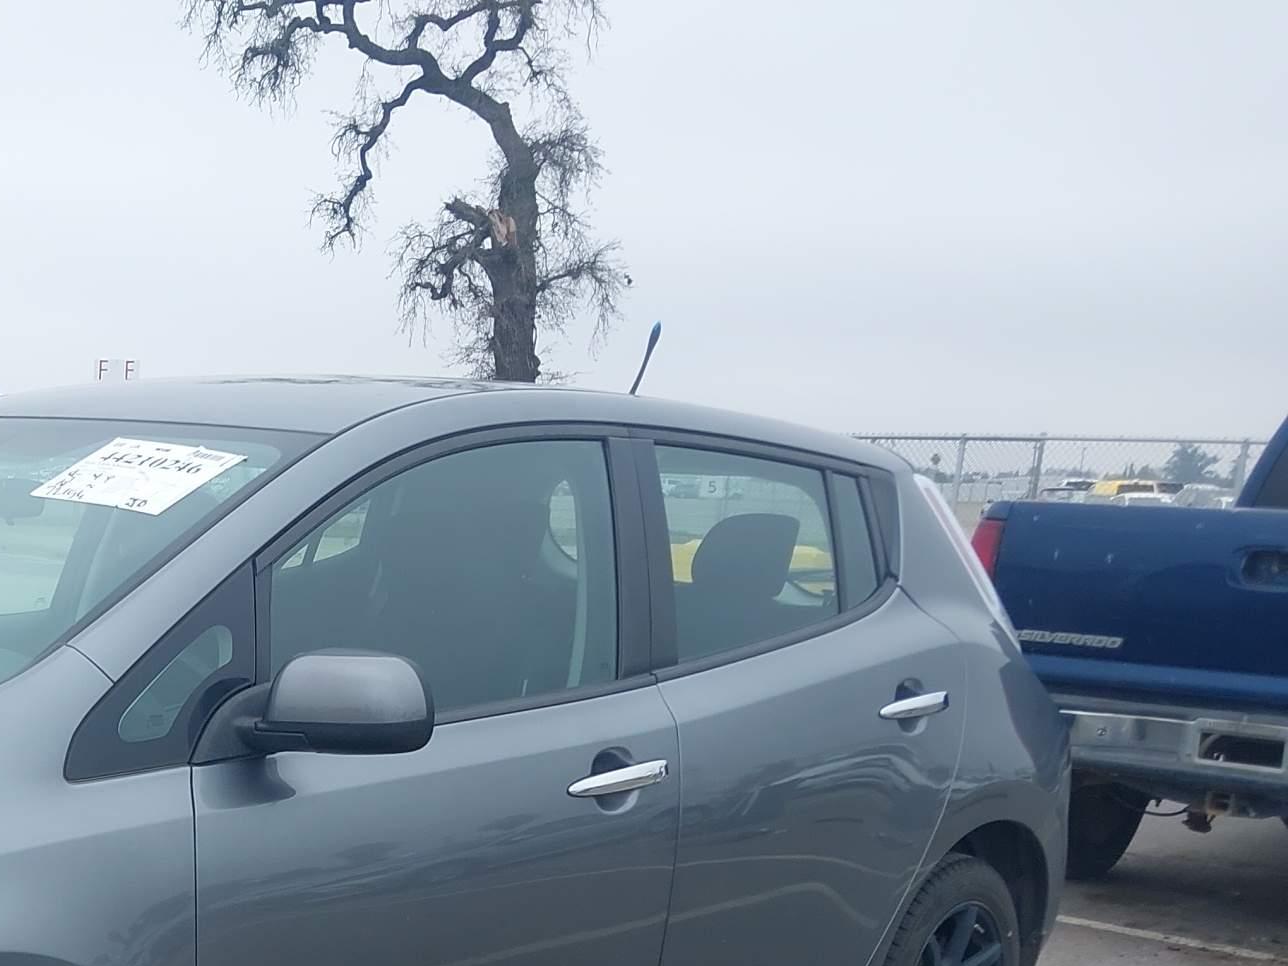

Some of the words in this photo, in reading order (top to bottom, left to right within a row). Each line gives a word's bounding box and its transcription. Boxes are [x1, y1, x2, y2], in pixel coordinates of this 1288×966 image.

[100, 451, 203, 474] 44210246
[707, 480, 718, 494] 5
[1018, 629, 1124, 648] SILVERADO
